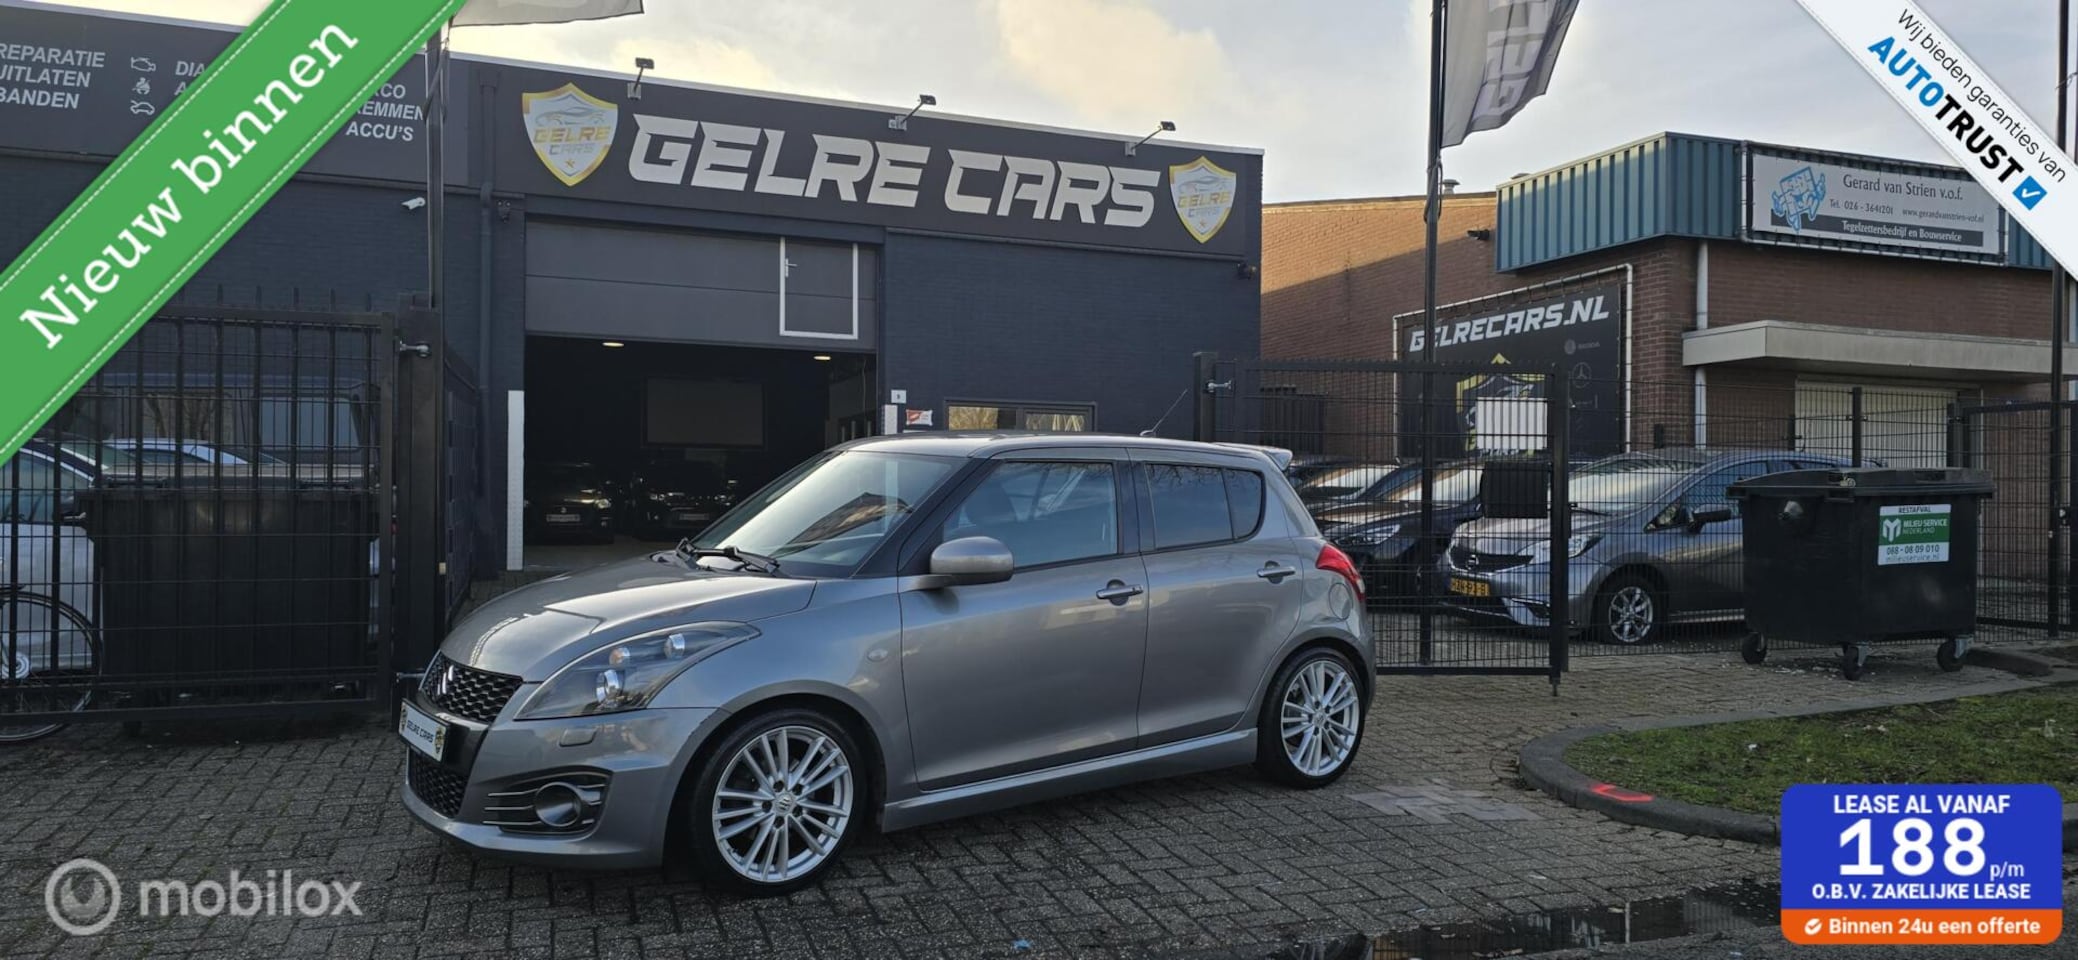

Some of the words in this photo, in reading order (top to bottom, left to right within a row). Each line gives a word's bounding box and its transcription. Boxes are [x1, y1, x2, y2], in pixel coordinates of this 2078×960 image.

[374, 83, 406, 99] CO
[356, 100, 424, 120] EMMEN
[345, 121, 414, 142] ACCU'S
[534, 126, 611, 143] GELRE
[629, 114, 931, 208] GELRE
[944, 149, 1161, 227] CARS
[1843, 174, 1880, 192] Gerard
[1884, 183, 1902, 194] van
[1906, 182, 1936, 198] Strien
[1940, 186, 1963, 201] v.o.f.
[1178, 190, 1230, 208] GELRE
[1844, 200, 1859, 210] 026
[1842, 220, 1908, 239] Tegelzettersbedrijf
[1908, 229, 1918, 239] en
[1919, 229, 1963, 242] Bouwservice
[1923, 518, 1948, 528] SERVICE
